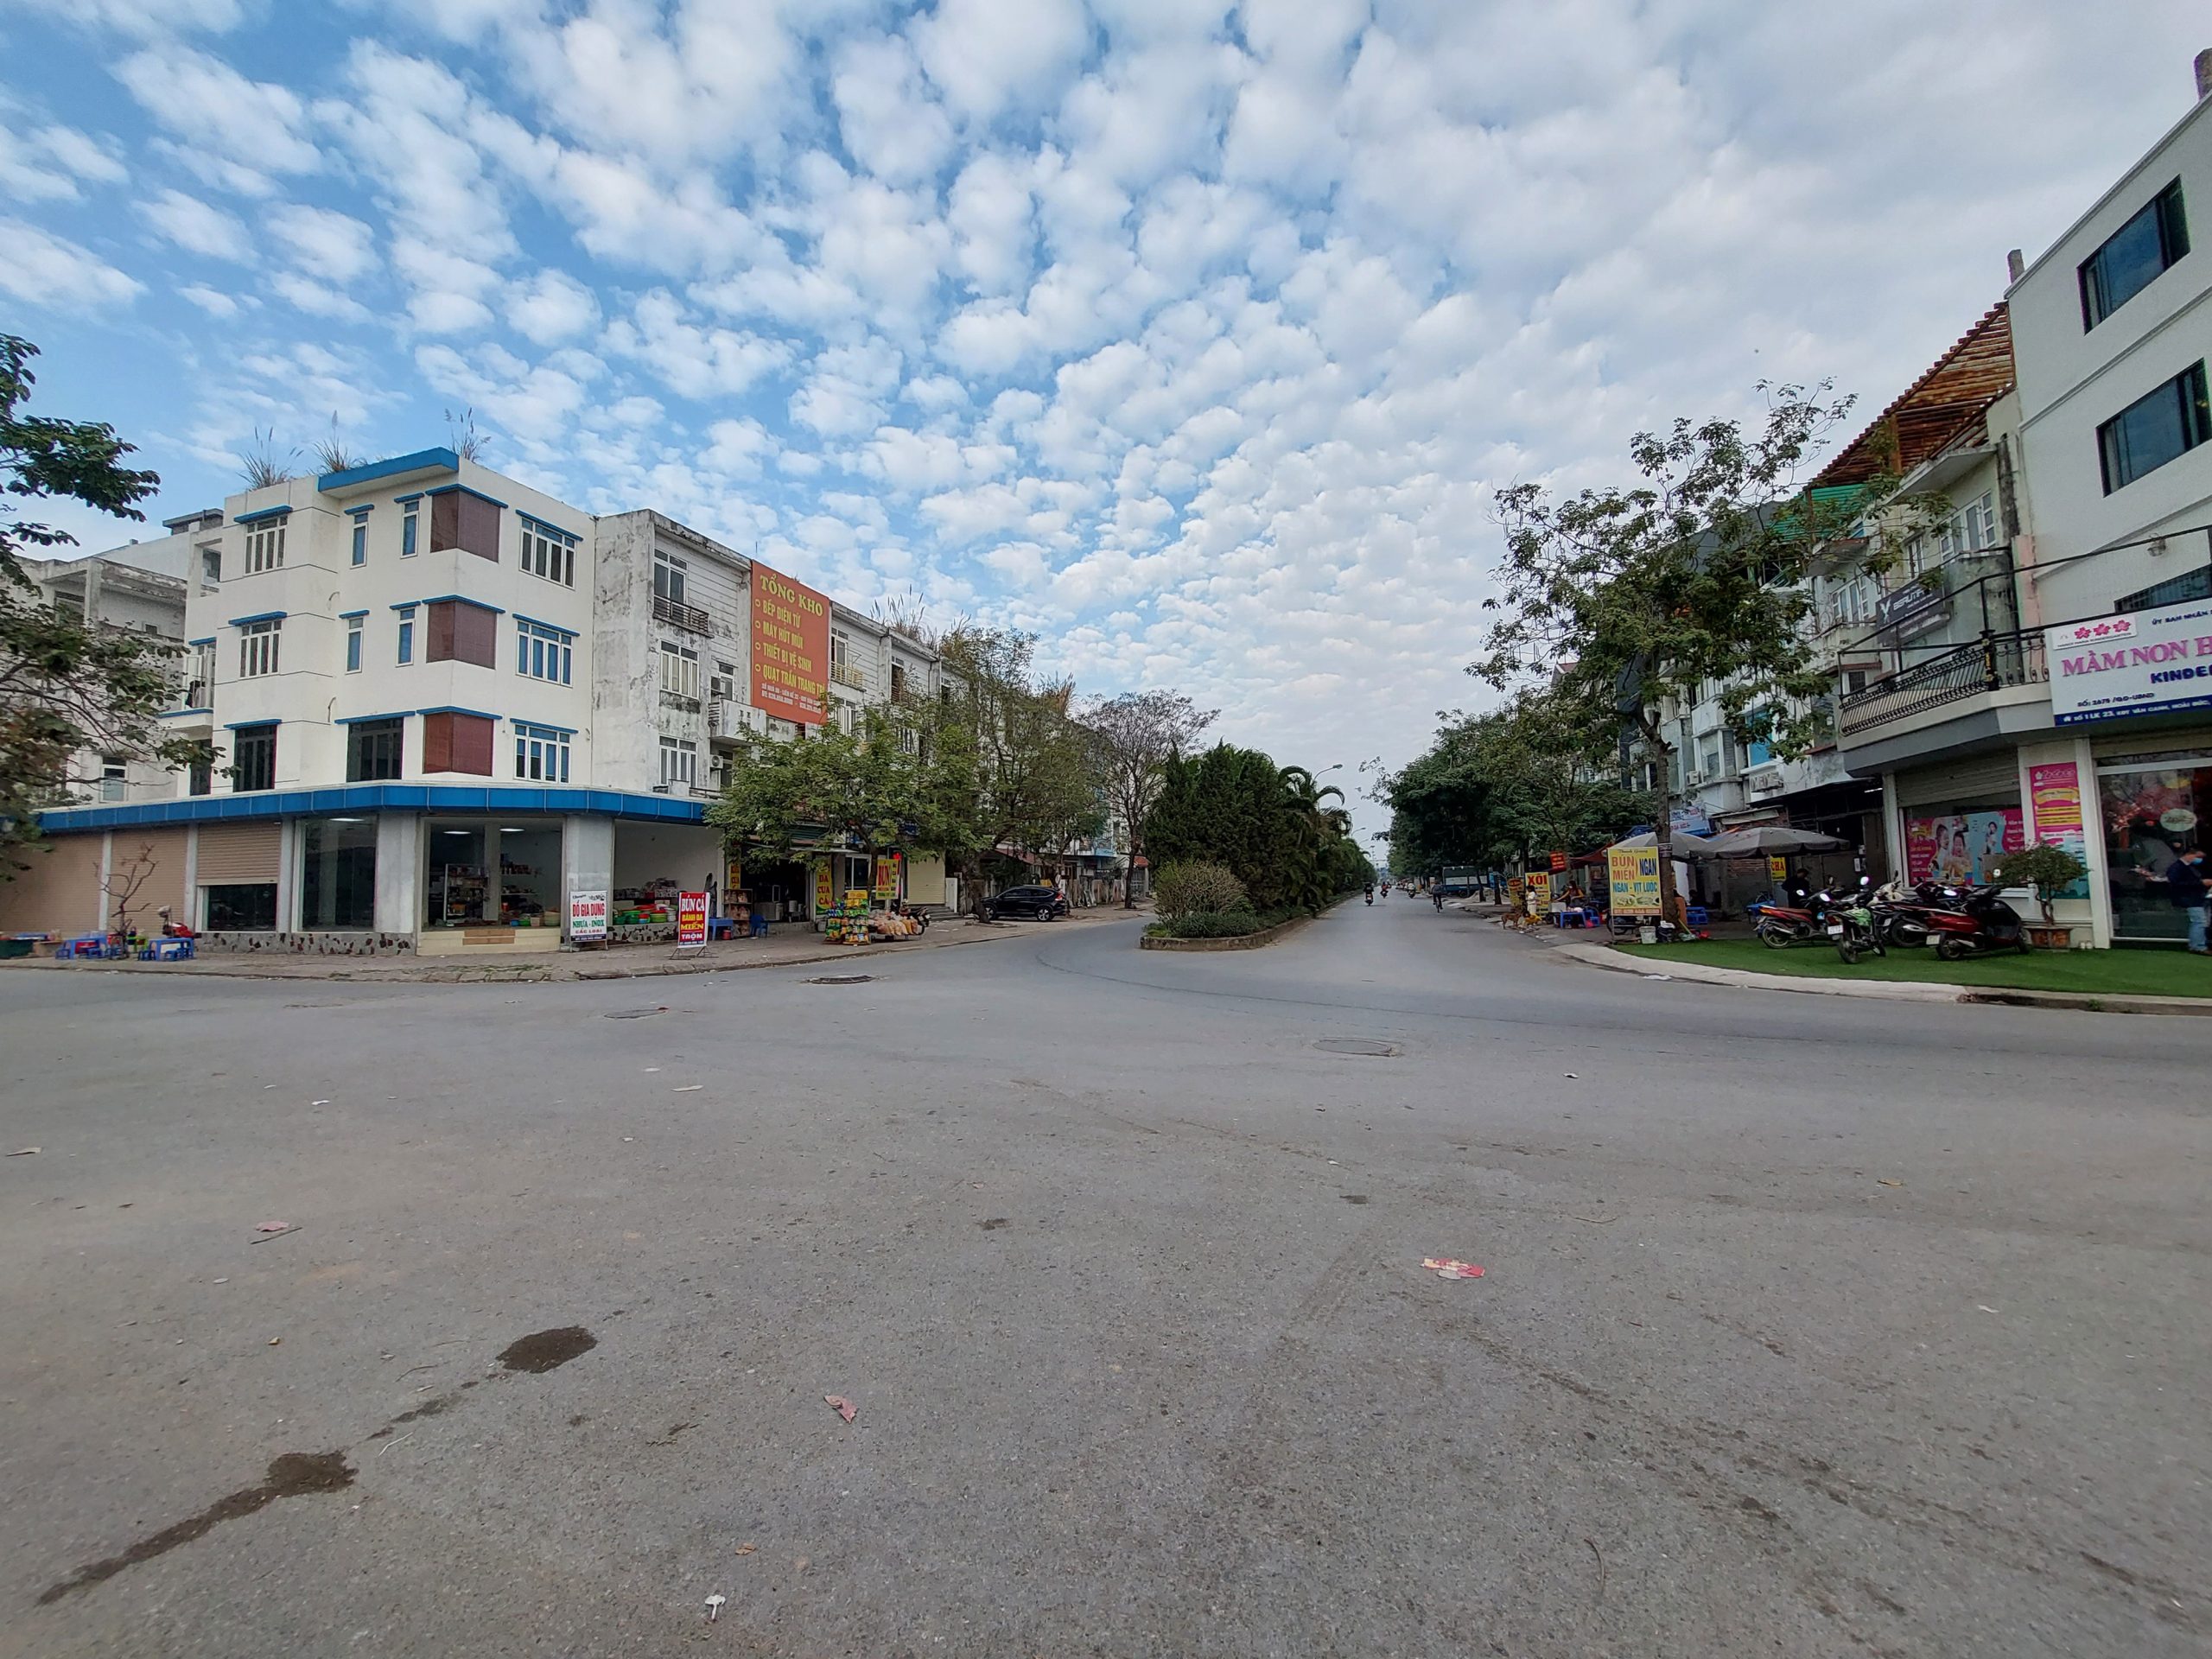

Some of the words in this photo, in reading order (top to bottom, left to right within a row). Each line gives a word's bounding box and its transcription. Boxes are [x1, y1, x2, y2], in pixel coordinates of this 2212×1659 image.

[760, 574, 796, 603] TỔNG
[798, 593, 823, 617] KHO
[762, 599, 776, 617] BẾP
[762, 642, 780, 661] THIẾT
[2129, 639, 2189, 666] NON
[1611, 854, 1635, 867] BÚN
[1639, 858, 1657, 876] NGAN
[1612, 882, 1628, 893] NGAN
[581, 903, 590, 917] GIA
[681, 894, 696, 912] BÚN
[696, 894, 705, 912] CÁ
[680, 921, 704, 931] MIẾN
